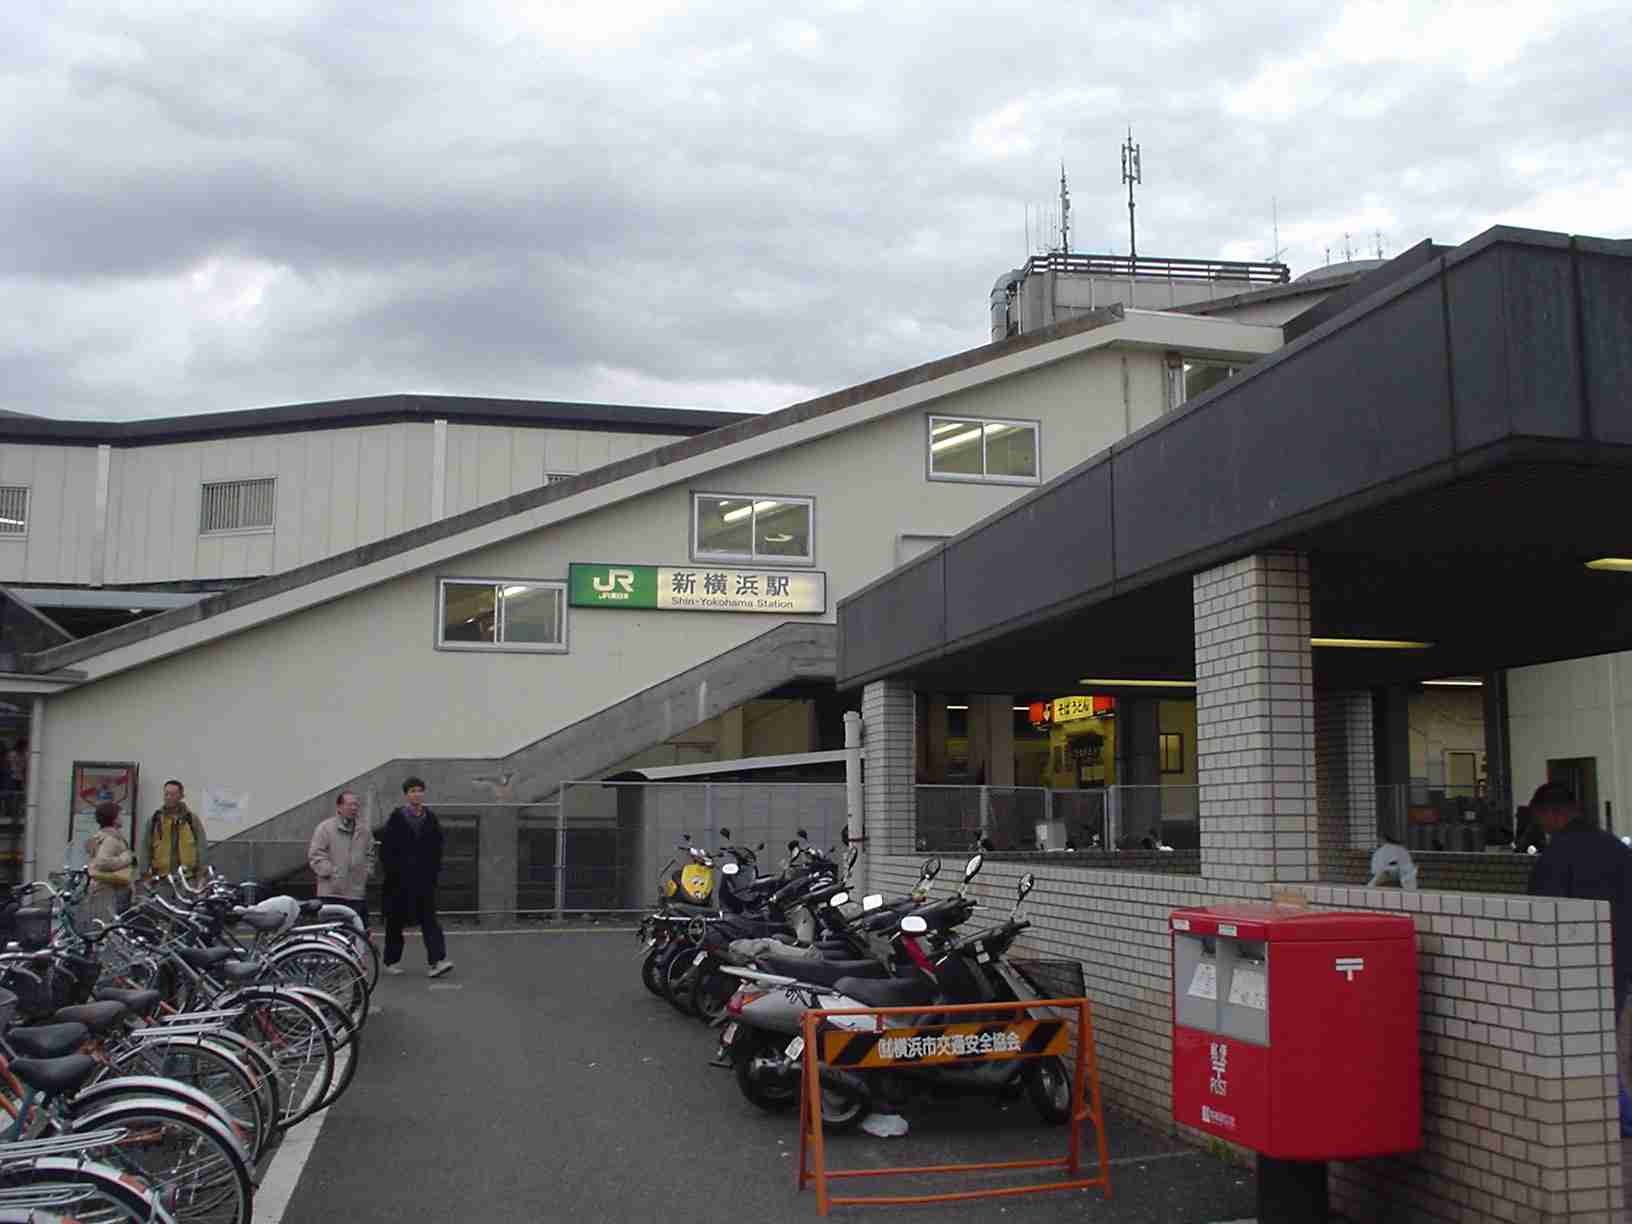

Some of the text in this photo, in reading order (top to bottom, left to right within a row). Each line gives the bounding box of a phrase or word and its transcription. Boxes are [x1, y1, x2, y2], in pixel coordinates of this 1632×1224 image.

[592, 569, 635, 592] JR
[672, 572, 790, 597] 新横浜駅
[671, 597, 794, 609] Shin-Yokohama Station
